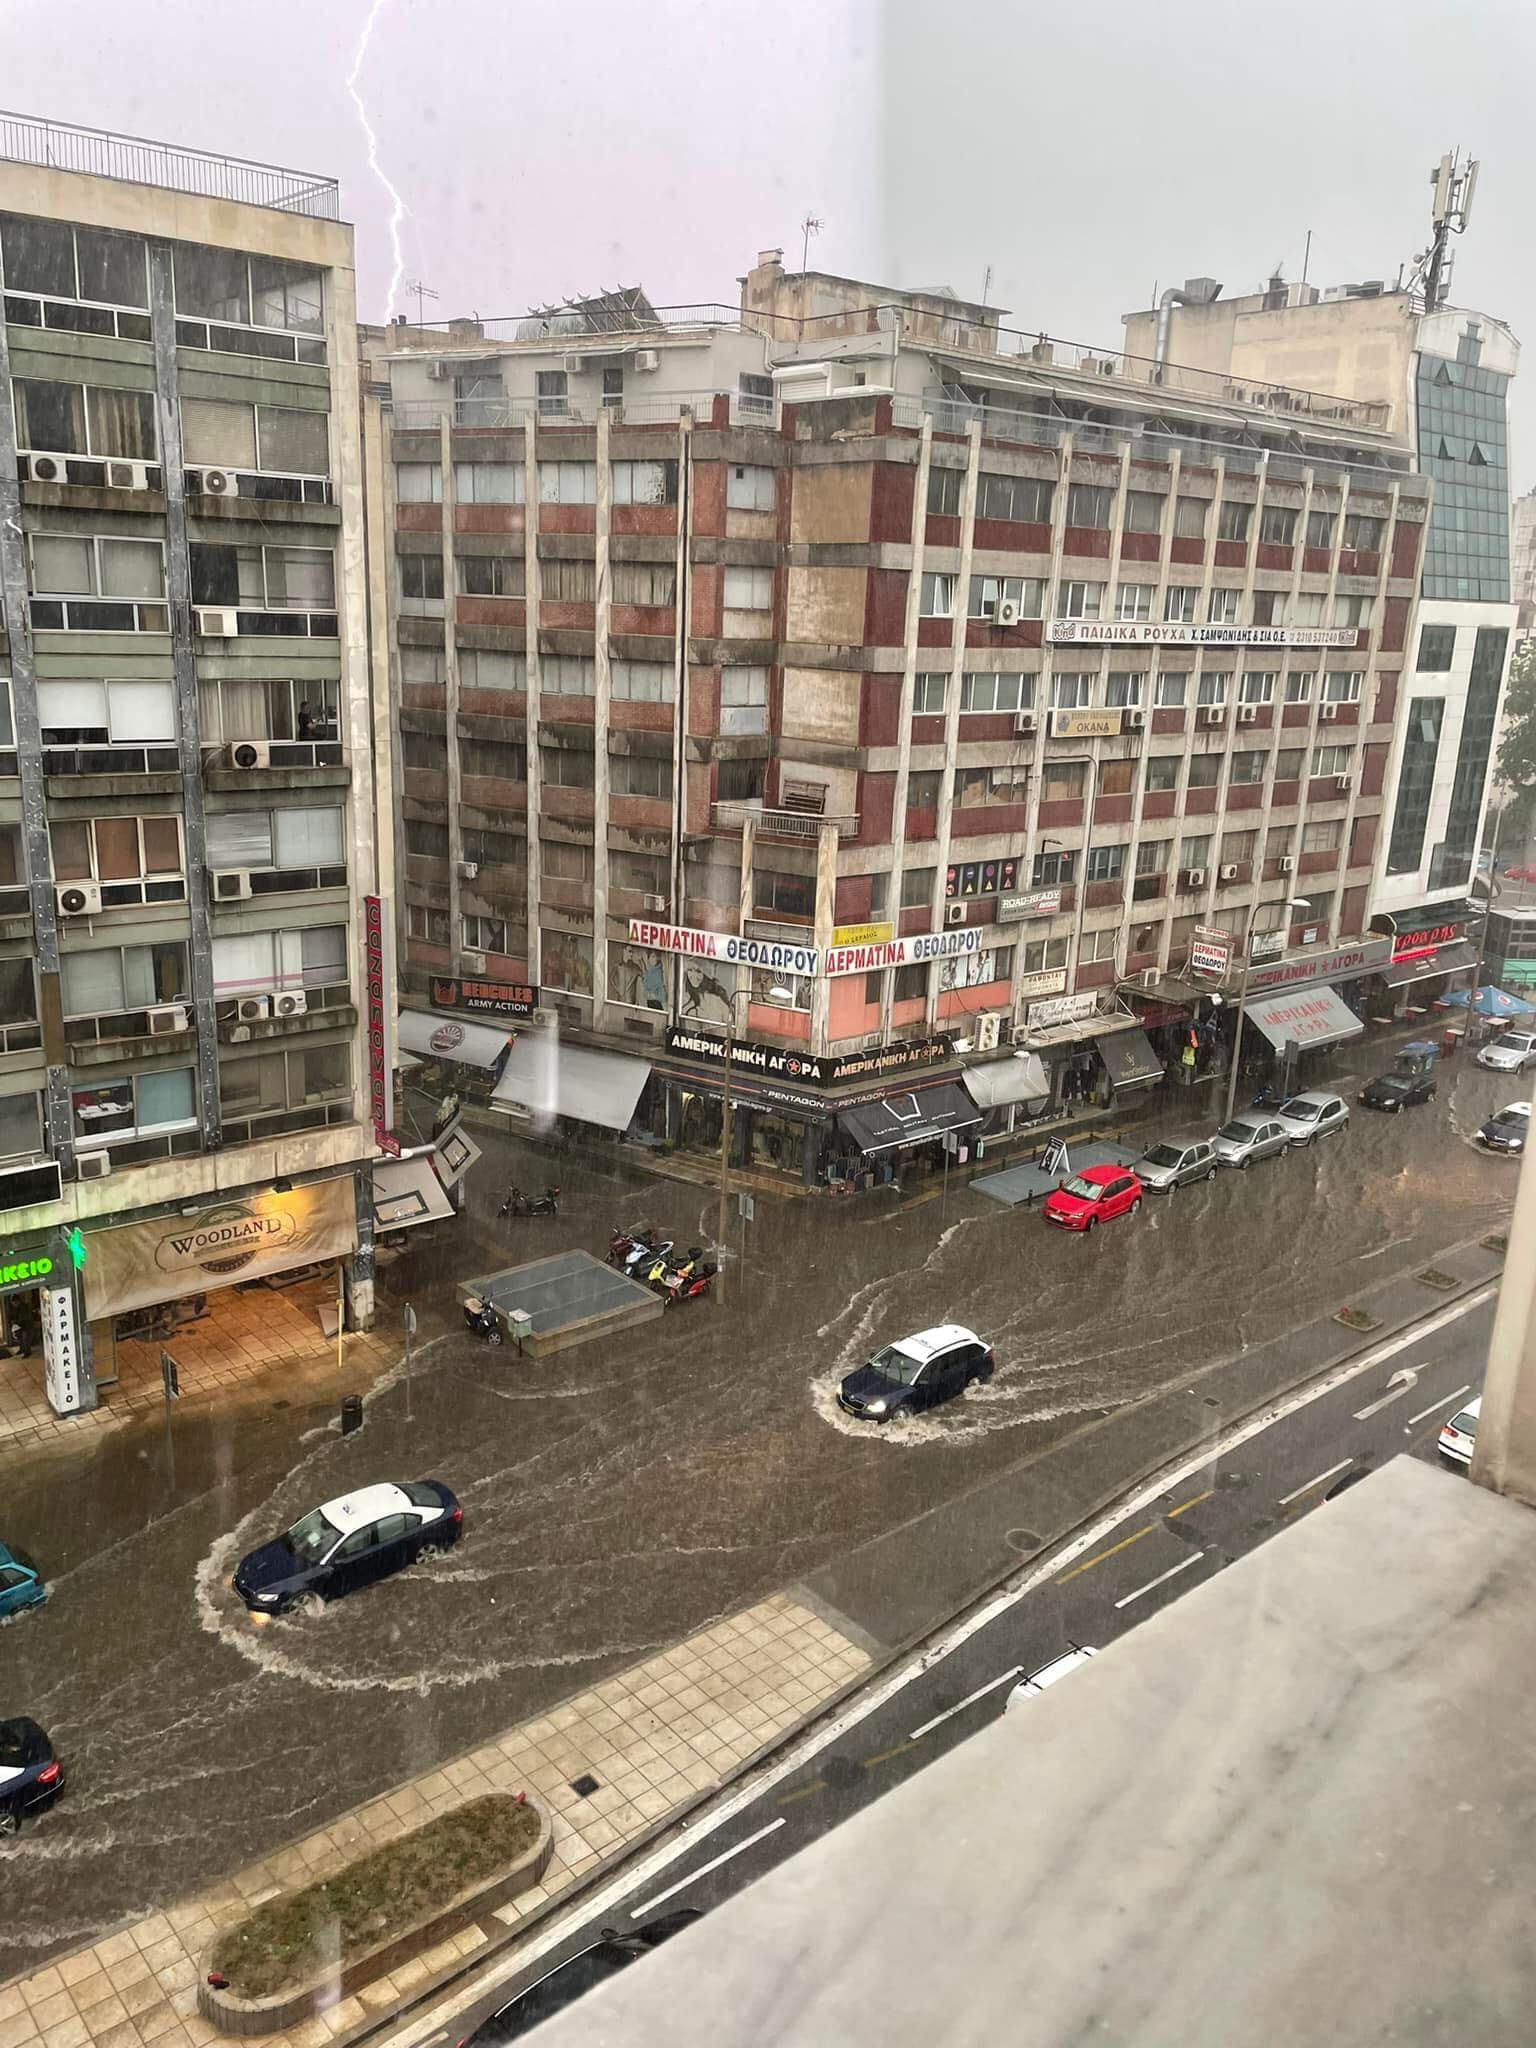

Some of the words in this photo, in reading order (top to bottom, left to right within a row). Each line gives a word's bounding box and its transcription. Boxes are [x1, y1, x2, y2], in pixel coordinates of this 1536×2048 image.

[1080, 626, 1137, 640] ΠΑΙΔΙΚΑ
[1144, 627, 1186, 641] ΡΟΥΧΑ
[1077, 722, 1110, 733] ΟΚΑΝΑ
[630, 922, 716, 956] ΔΕΡΜΑΤΙΝΑ
[727, 938, 818, 972] ΘΕΟΔΩΡΟΥ
[826, 942, 905, 973] ΔΕΡΜΑΤΙΝΑ
[914, 930, 983, 960] ΘΕΟΔΩΡΟΥ
[1194, 943, 1226, 958] ΔΕΡΜΑΤΙΝΑ
[1193, 954, 1225, 970] ΘΕΟΔΩΡΟΥ
[1331, 952, 1365, 970] ΑΓΟΡΑ
[461, 982, 533, 1003] HERCULES
[467, 998, 493, 1009] ARMY
[495, 1001, 528, 1012] ACTION
[833, 1052, 907, 1078] ΑΜΕΡΙΚΑΝΙΚΗ
[768, 1090, 825, 1109] PENTAGON
[838, 1091, 886, 1107] PENTAGON
[170, 1219, 281, 1255] WOODLAND
[0, 1257, 53, 1285] ΚΕΙΟ
[58, 1296, 74, 1403] ΦΑΡΜΑΚΕΙΟ
